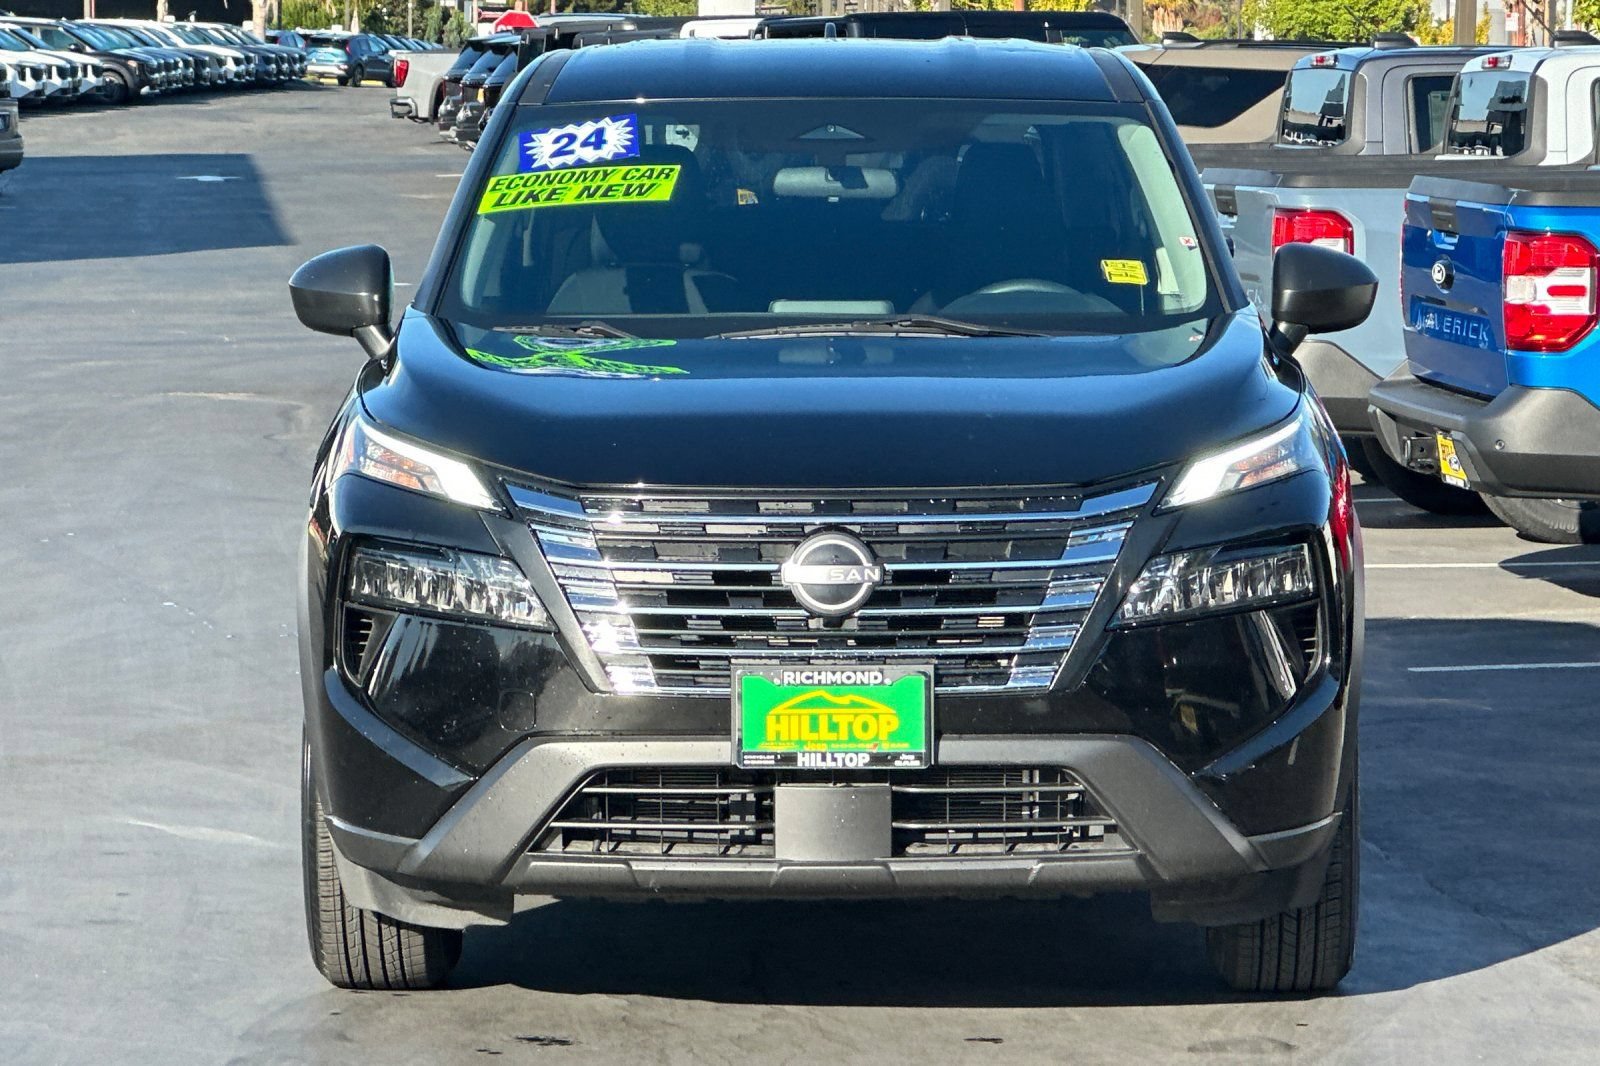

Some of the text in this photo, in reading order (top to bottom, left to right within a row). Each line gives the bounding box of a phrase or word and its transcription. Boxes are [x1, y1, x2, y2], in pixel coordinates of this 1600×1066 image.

[551, 126, 608, 159] 24
[489, 167, 676, 192] ECONOMY CAR
[491, 182, 659, 209] LIKE NEW
[1415, 309, 1489, 342] MERICK
[783, 671, 883, 685] RICHMOND
[765, 714, 900, 741] HILLTOP
[796, 752, 871, 767] HILLTOP
